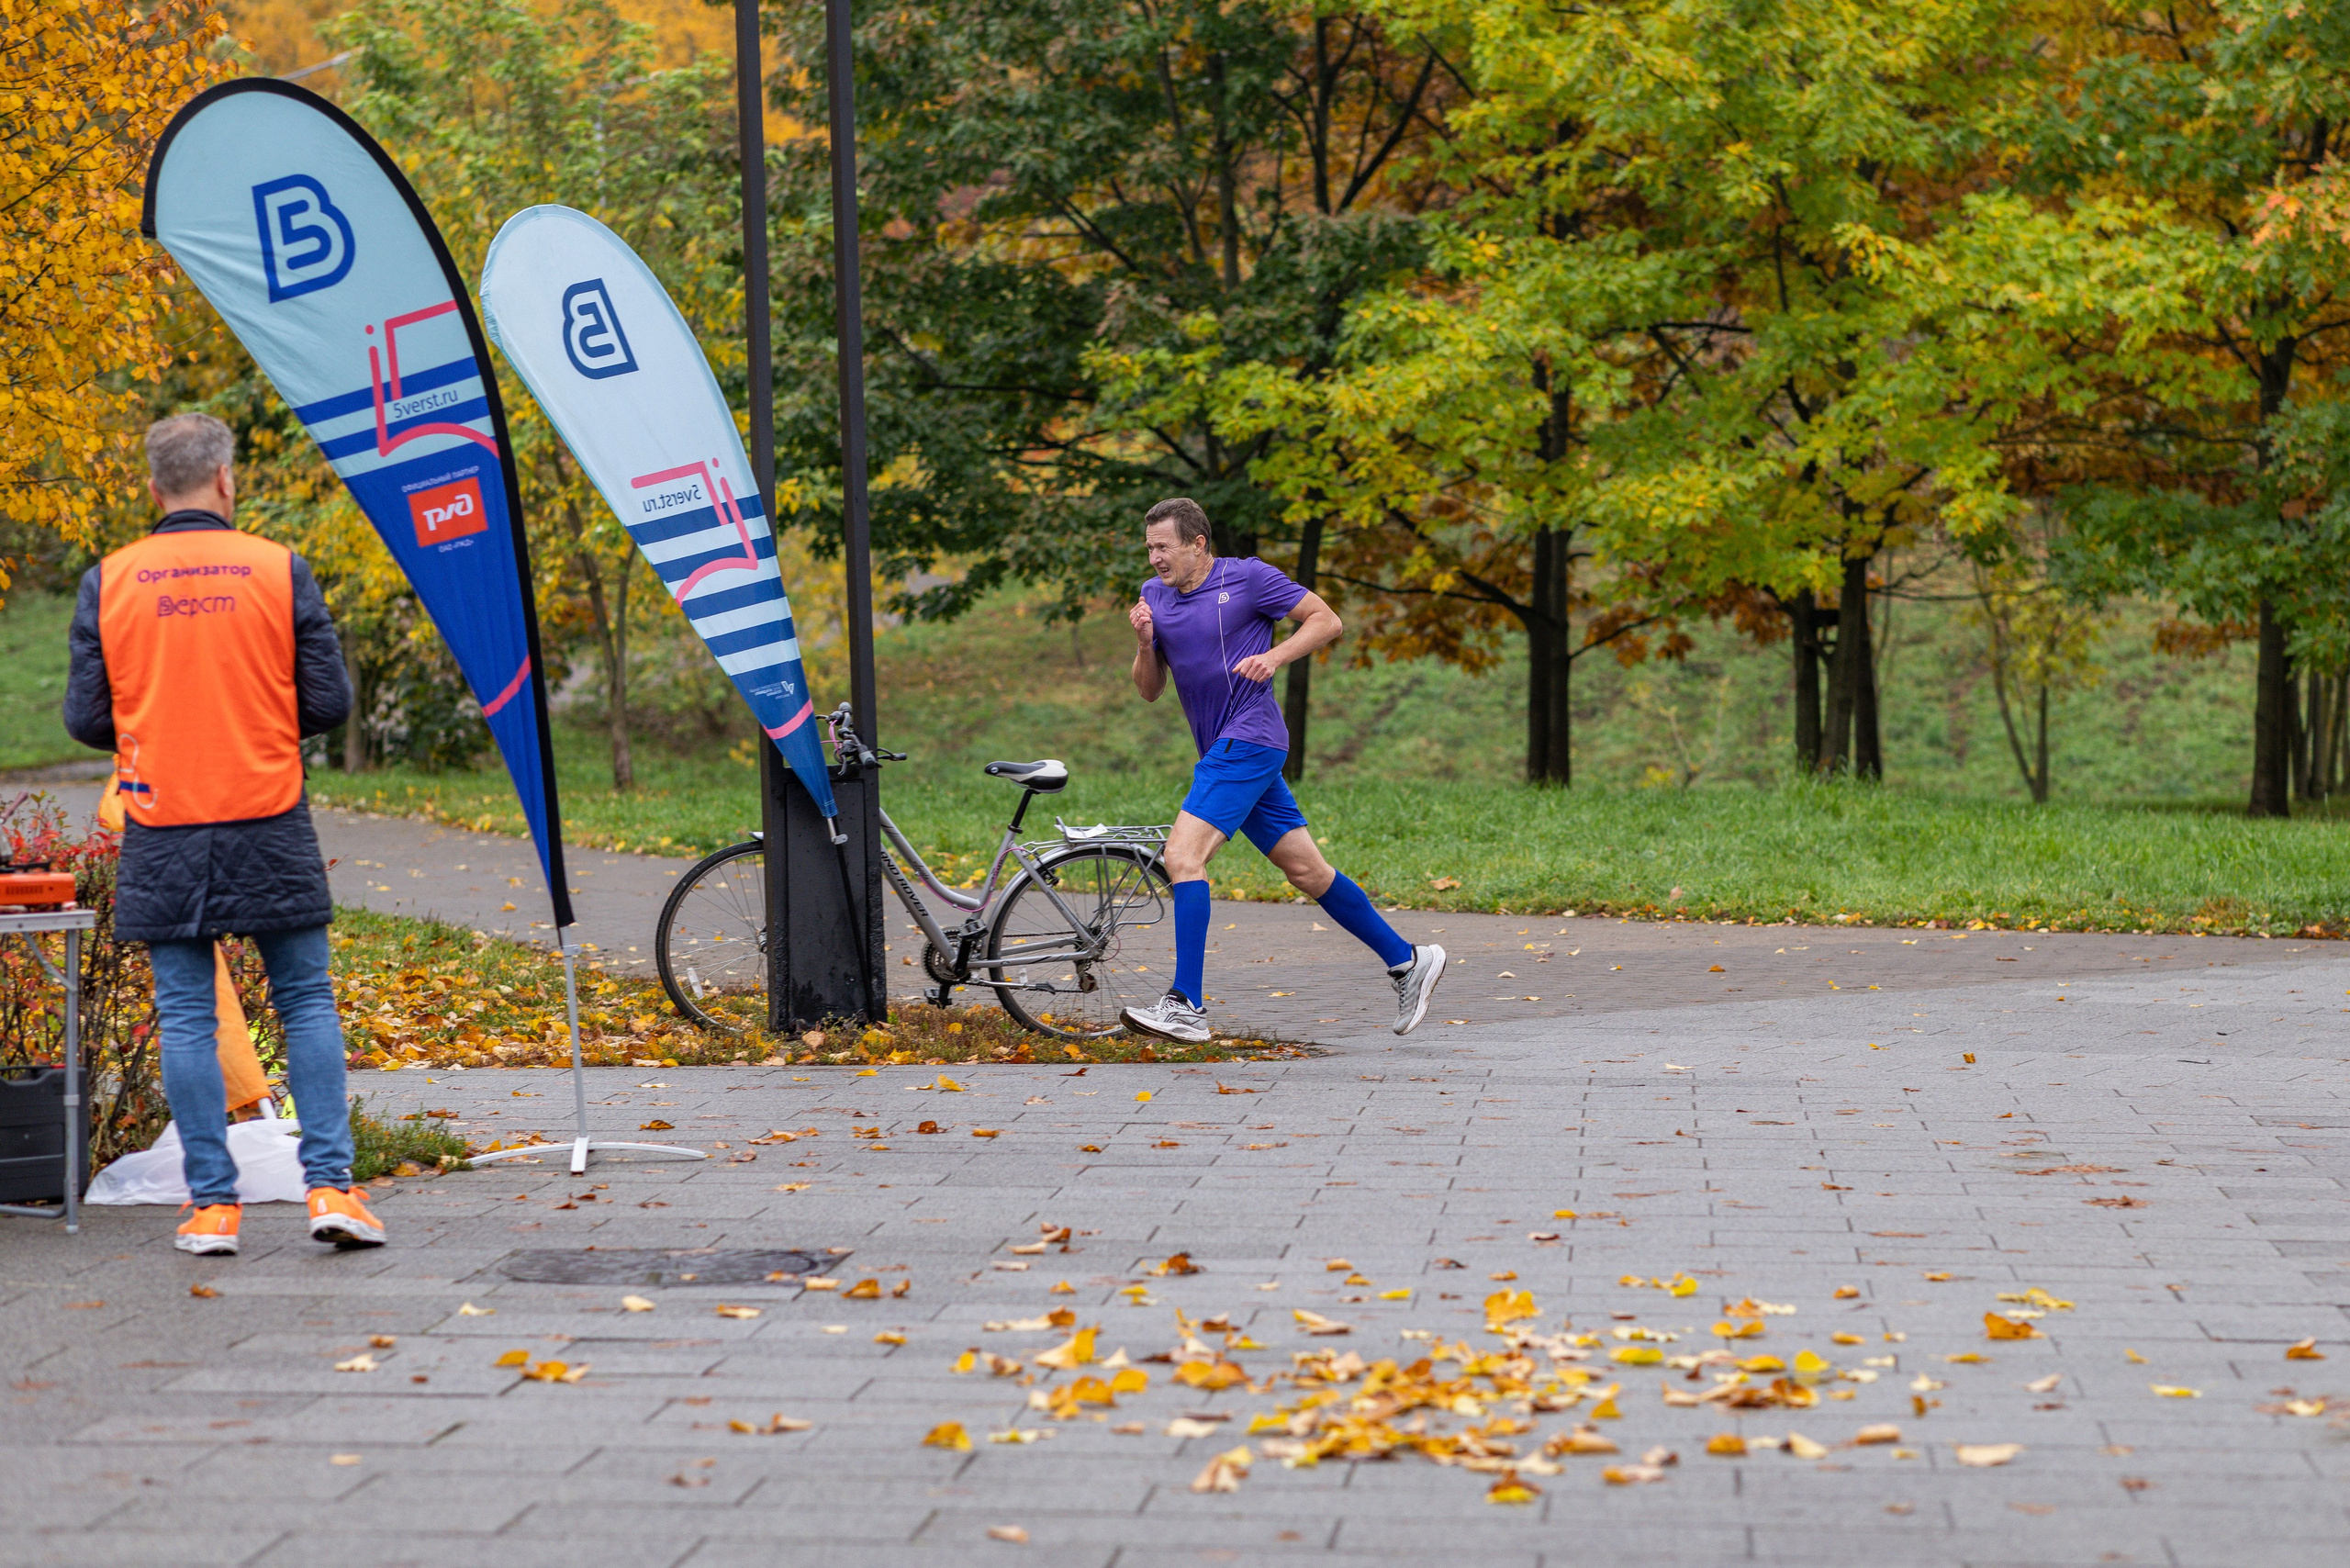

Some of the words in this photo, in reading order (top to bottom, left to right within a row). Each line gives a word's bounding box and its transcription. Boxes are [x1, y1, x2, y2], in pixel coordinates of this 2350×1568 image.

[394, 390, 459, 419] 5verst.ru
[138, 566, 252, 583] Организатор
[880, 850, 900, 876] AND
[897, 878, 929, 917] ROVER
